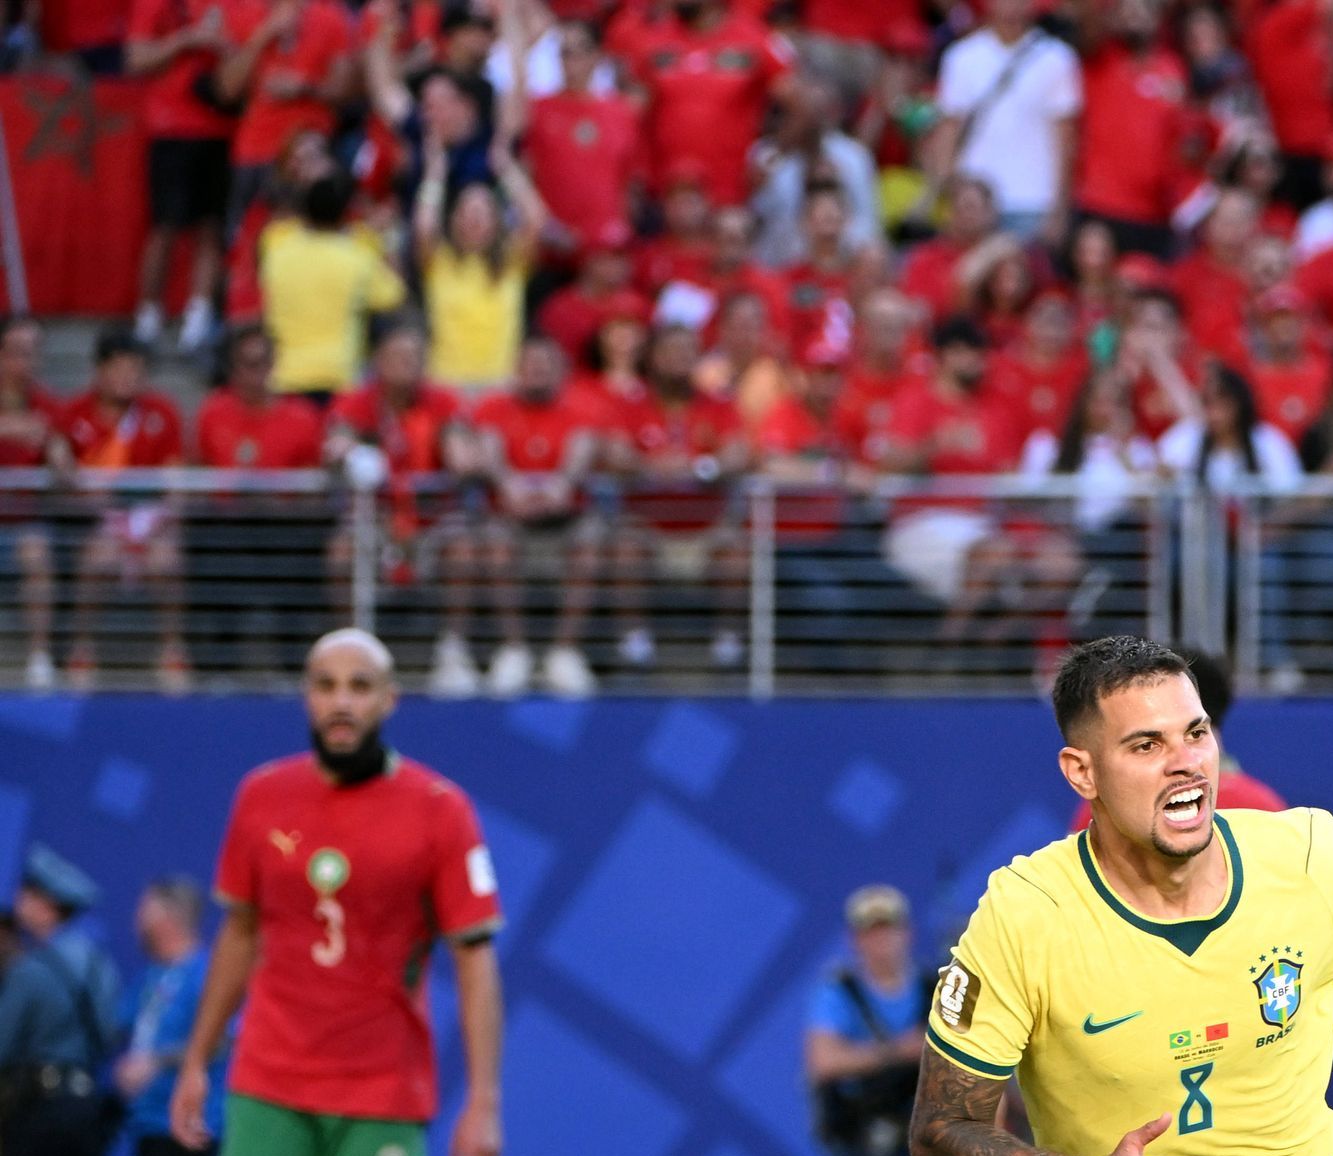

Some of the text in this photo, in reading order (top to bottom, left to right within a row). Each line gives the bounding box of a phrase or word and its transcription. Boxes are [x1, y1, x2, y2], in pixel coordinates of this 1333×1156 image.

[310, 899, 346, 967] 3
[1272, 985, 1290, 999] CBF
[1178, 1061, 1214, 1136] 8
